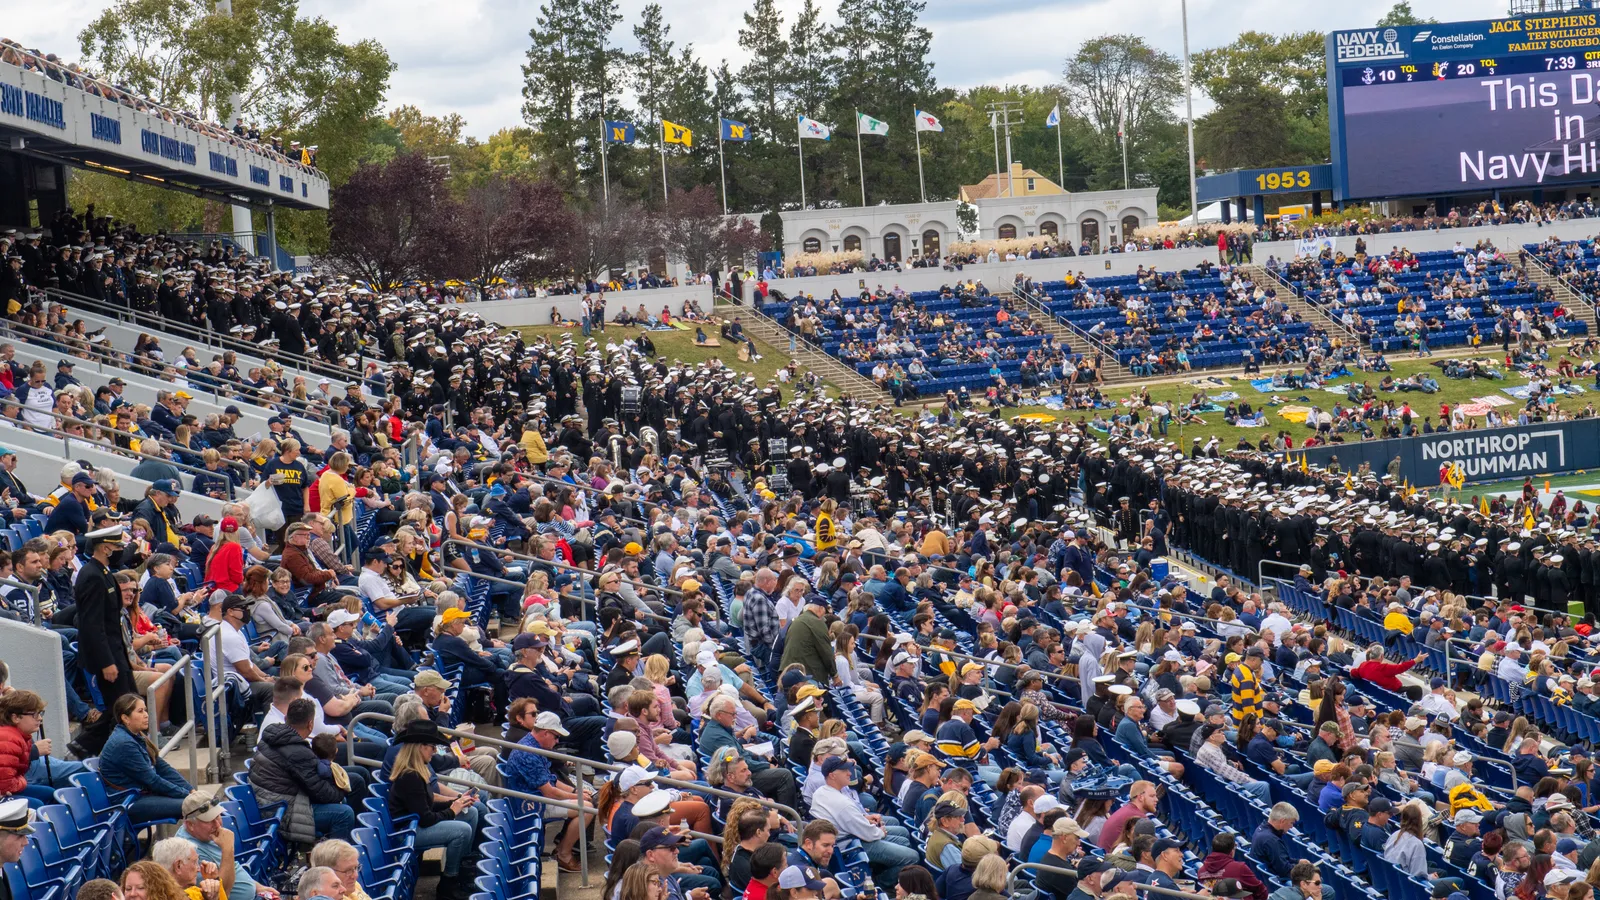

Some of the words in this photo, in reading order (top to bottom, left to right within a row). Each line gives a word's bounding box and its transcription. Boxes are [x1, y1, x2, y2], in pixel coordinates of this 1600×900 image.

[1489, 20, 1522, 34] JACK
[1525, 14, 1597, 31] STEPHENS
[1336, 31, 1379, 46] NAVY
[1431, 32, 1485, 44] Constellation
[1527, 27, 1600, 40] TERWILLIGER
[1338, 42, 1404, 59] FEDERAL
[1508, 41, 1547, 52] FAMILY
[1550, 37, 1600, 49] SCOREBO
[1400, 65, 1418, 73] TOL
[1457, 64, 1475, 75] 20
[1480, 59, 1497, 67] TOL
[1545, 56, 1576, 71] 7:39
[1379, 70, 1396, 81] 10
[1481, 76, 1558, 111] This
[730, 125, 745, 138] N
[869, 120, 881, 131] T
[1554, 109, 1584, 141] in
[613, 127, 626, 141] N
[672, 127, 684, 139] N
[1460, 150, 1551, 183] Navy
[1563, 141, 1597, 174] Hi
[1256, 171, 1311, 190] 1953
[1422, 433, 1530, 460] NORTHROP
